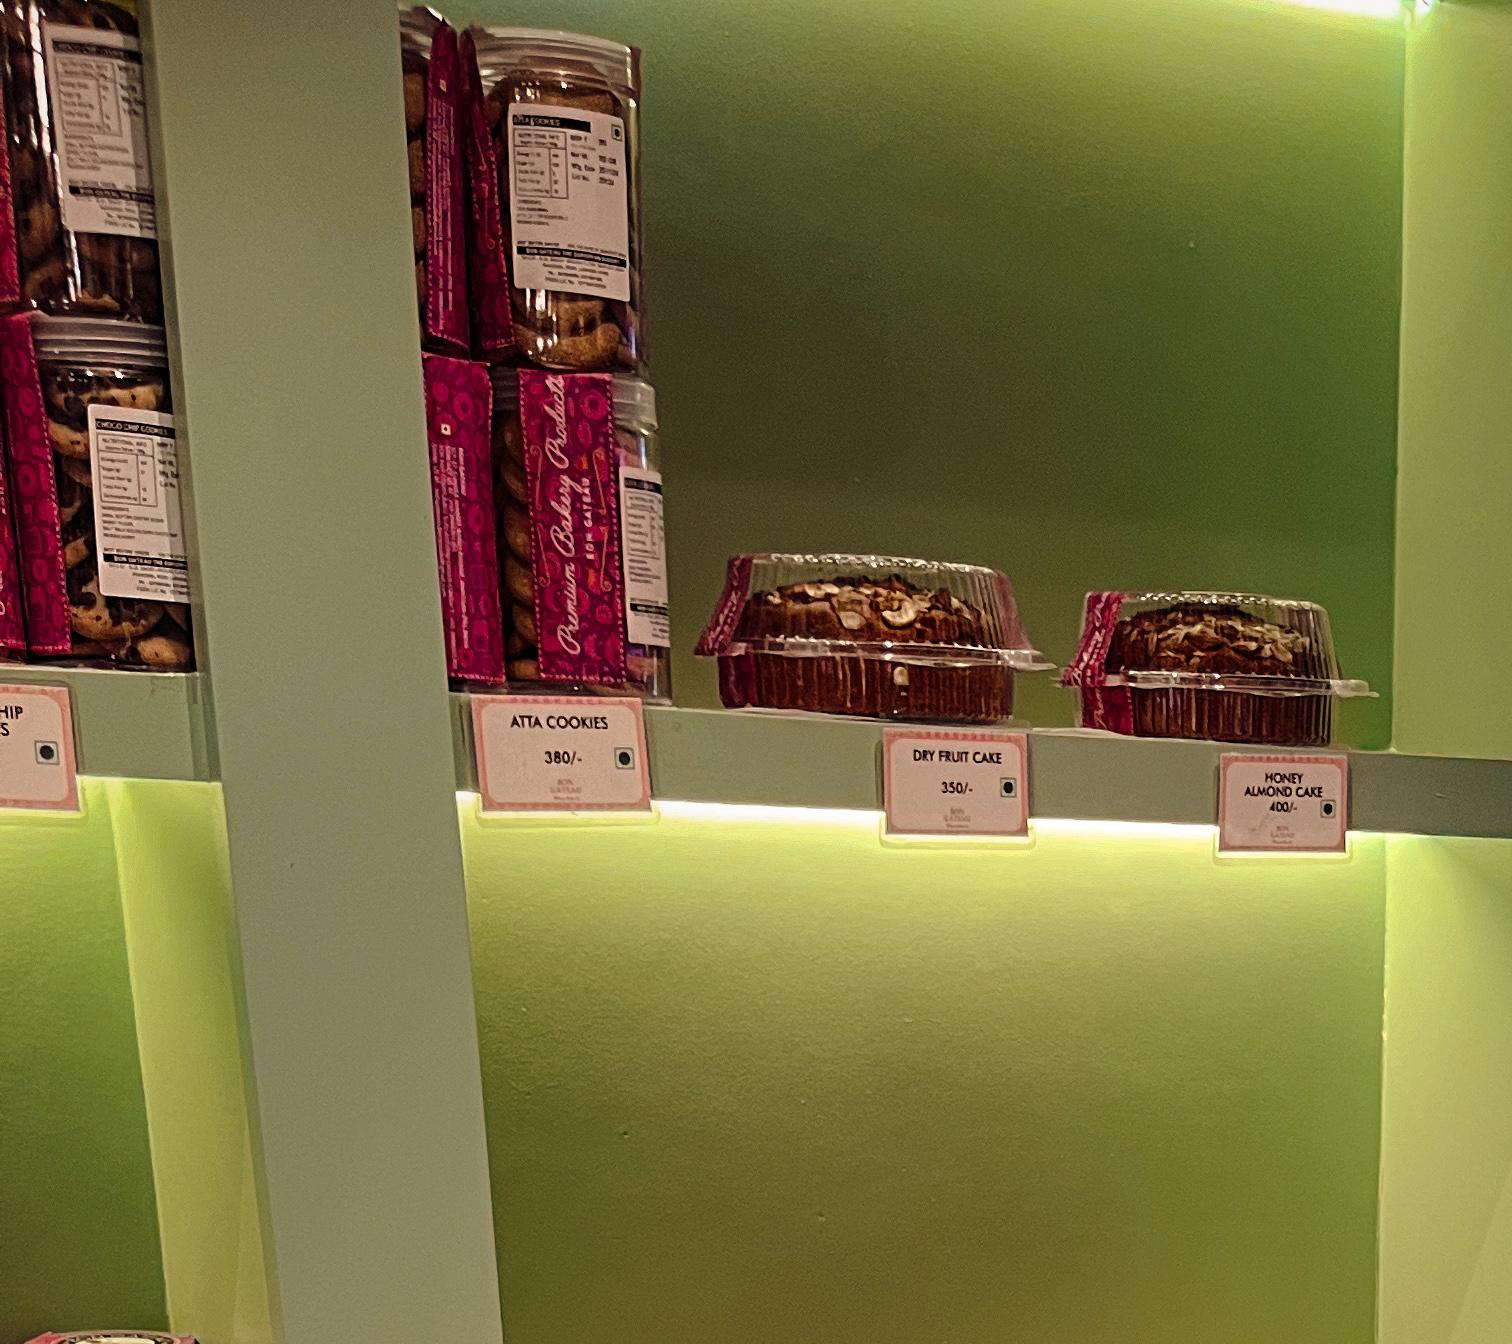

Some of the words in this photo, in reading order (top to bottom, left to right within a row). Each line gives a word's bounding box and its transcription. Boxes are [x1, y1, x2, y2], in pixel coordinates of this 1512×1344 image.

[542, 375, 568, 469] Products
[550, 474, 583, 557] Bakery
[556, 562, 581, 655] Premium
[510, 715, 543, 729] ATTA
[546, 715, 609, 730] COOKIES
[544, 750, 583, 765] 380/-
[913, 749, 935, 761] DRY
[938, 750, 970, 763] FRUIT
[972, 751, 1003, 765] CAKE
[1264, 772, 1304, 784] HONEY
[941, 781, 973, 795] 350/-
[1244, 785, 1292, 798] ALMOND
[1295, 786, 1323, 798] CAKE
[1269, 802, 1298, 813] 400/-
